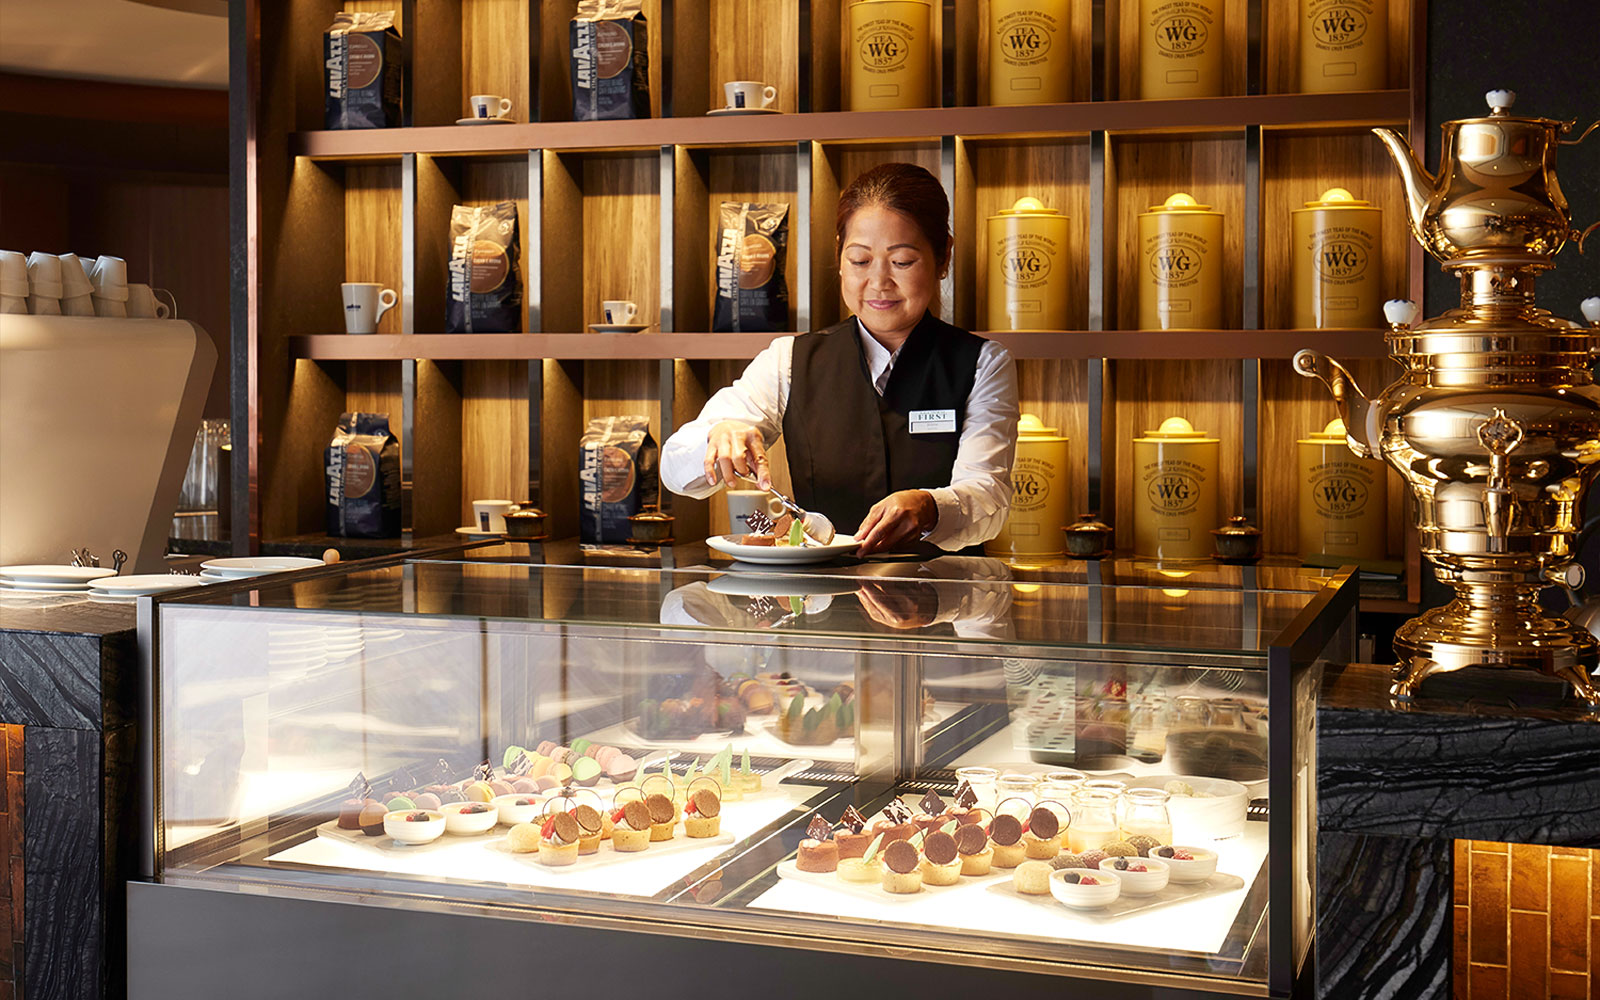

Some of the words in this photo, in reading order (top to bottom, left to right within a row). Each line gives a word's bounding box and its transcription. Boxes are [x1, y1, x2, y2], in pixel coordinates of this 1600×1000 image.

[1322, 18, 1356, 33] WG
[1165, 26, 1197, 41] WG
[868, 43, 898, 56] WG
[1009, 34, 1040, 50] WG
[326, 29, 343, 98] LAVAZZA
[718, 228, 738, 299] LAVAZZA
[1010, 258, 1040, 272] WG
[1159, 256, 1190, 271] WG
[1325, 252, 1357, 267] WG
[449, 236, 469, 302] LAVAZZA
[580, 442, 600, 511] LAVAZZA
[1157, 484, 1189, 499] WG
[1323, 487, 1356, 502] WG
